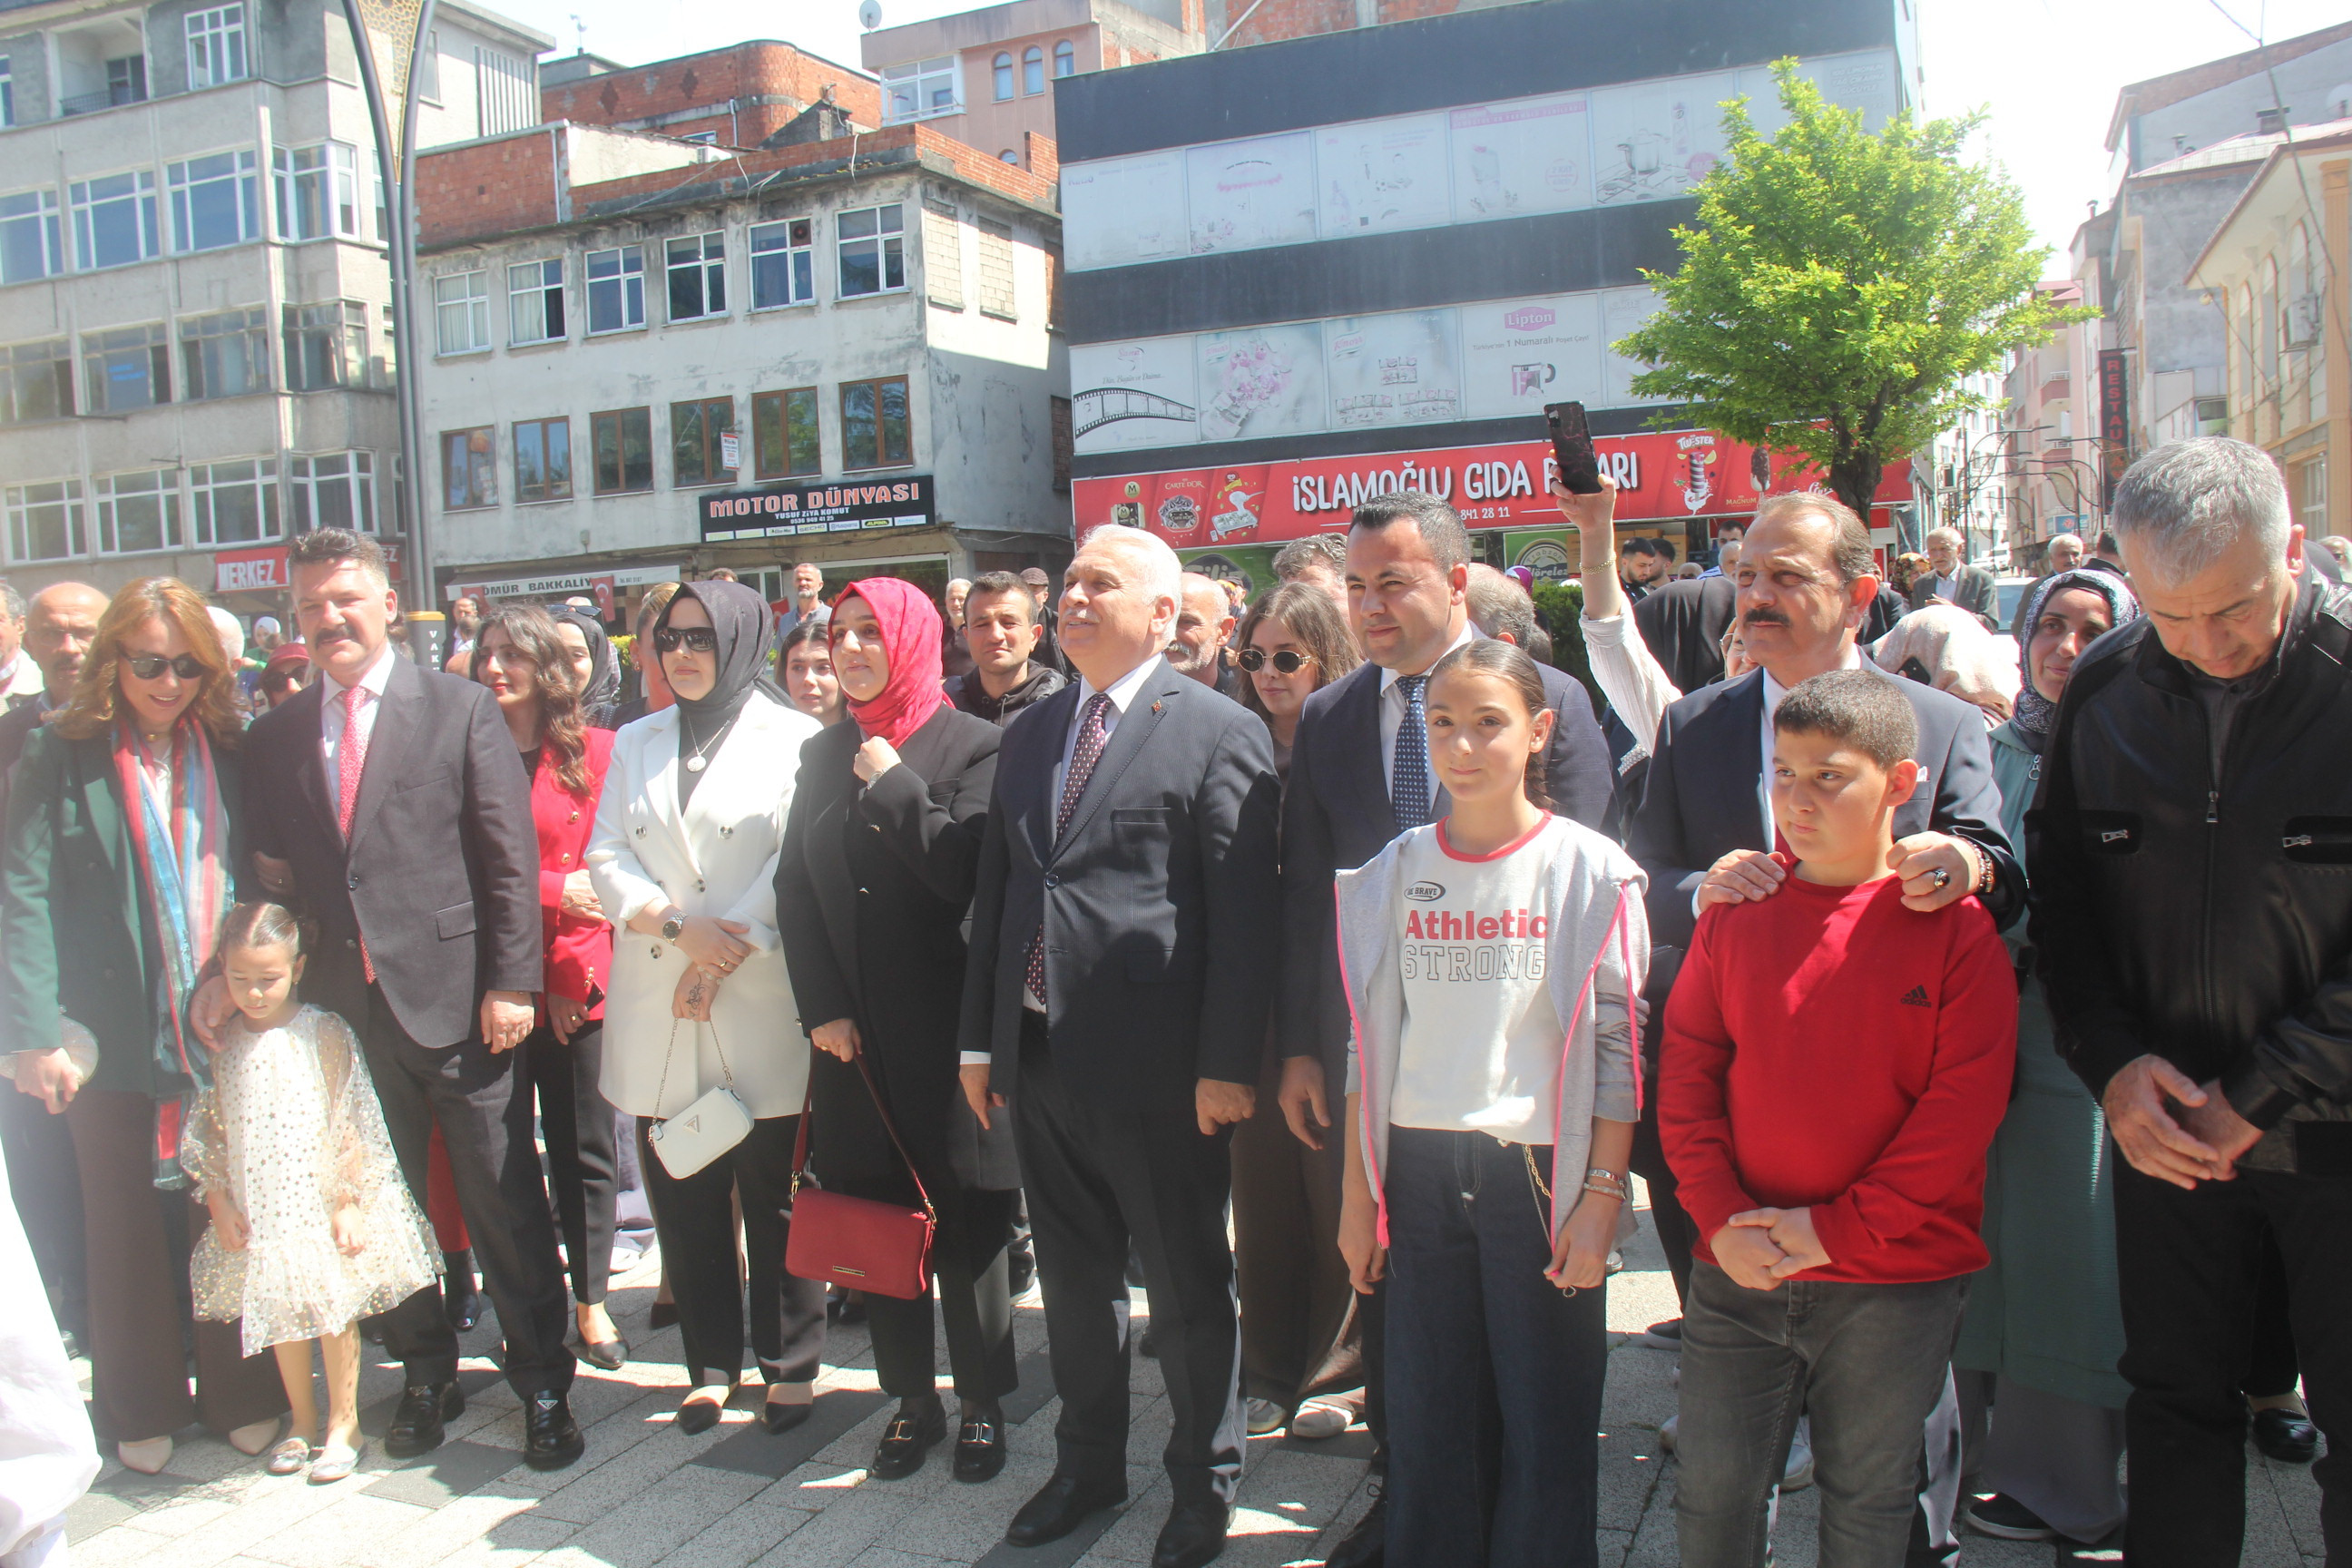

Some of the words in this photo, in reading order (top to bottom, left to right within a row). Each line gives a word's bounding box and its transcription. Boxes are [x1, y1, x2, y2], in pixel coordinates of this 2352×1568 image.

[1507, 312, 1553, 328] Lipton
[1514, 337, 1553, 347] Numaralı
[1164, 482, 1185, 490] CARTE
[1463, 459, 1533, 500] GIDA
[710, 494, 799, 518] MOTOR
[808, 482, 920, 510] DÜNYASI
[1726, 497, 1757, 505] MAGNUM
[775, 511, 800, 520] YUSUF
[820, 506, 850, 515] KOMUT
[1460, 508, 1479, 521] 841
[1482, 507, 1494, 519] 28
[1498, 506, 1511, 518] 11
[1527, 550, 1563, 563] Trabzon
[218, 559, 277, 590] MERKEZ
[528, 577, 591, 591] BAKKALİY
[1415, 887, 1437, 896] BRAVE
[1405, 908, 1548, 941] Athletic
[1404, 945, 1546, 982] STRONG
